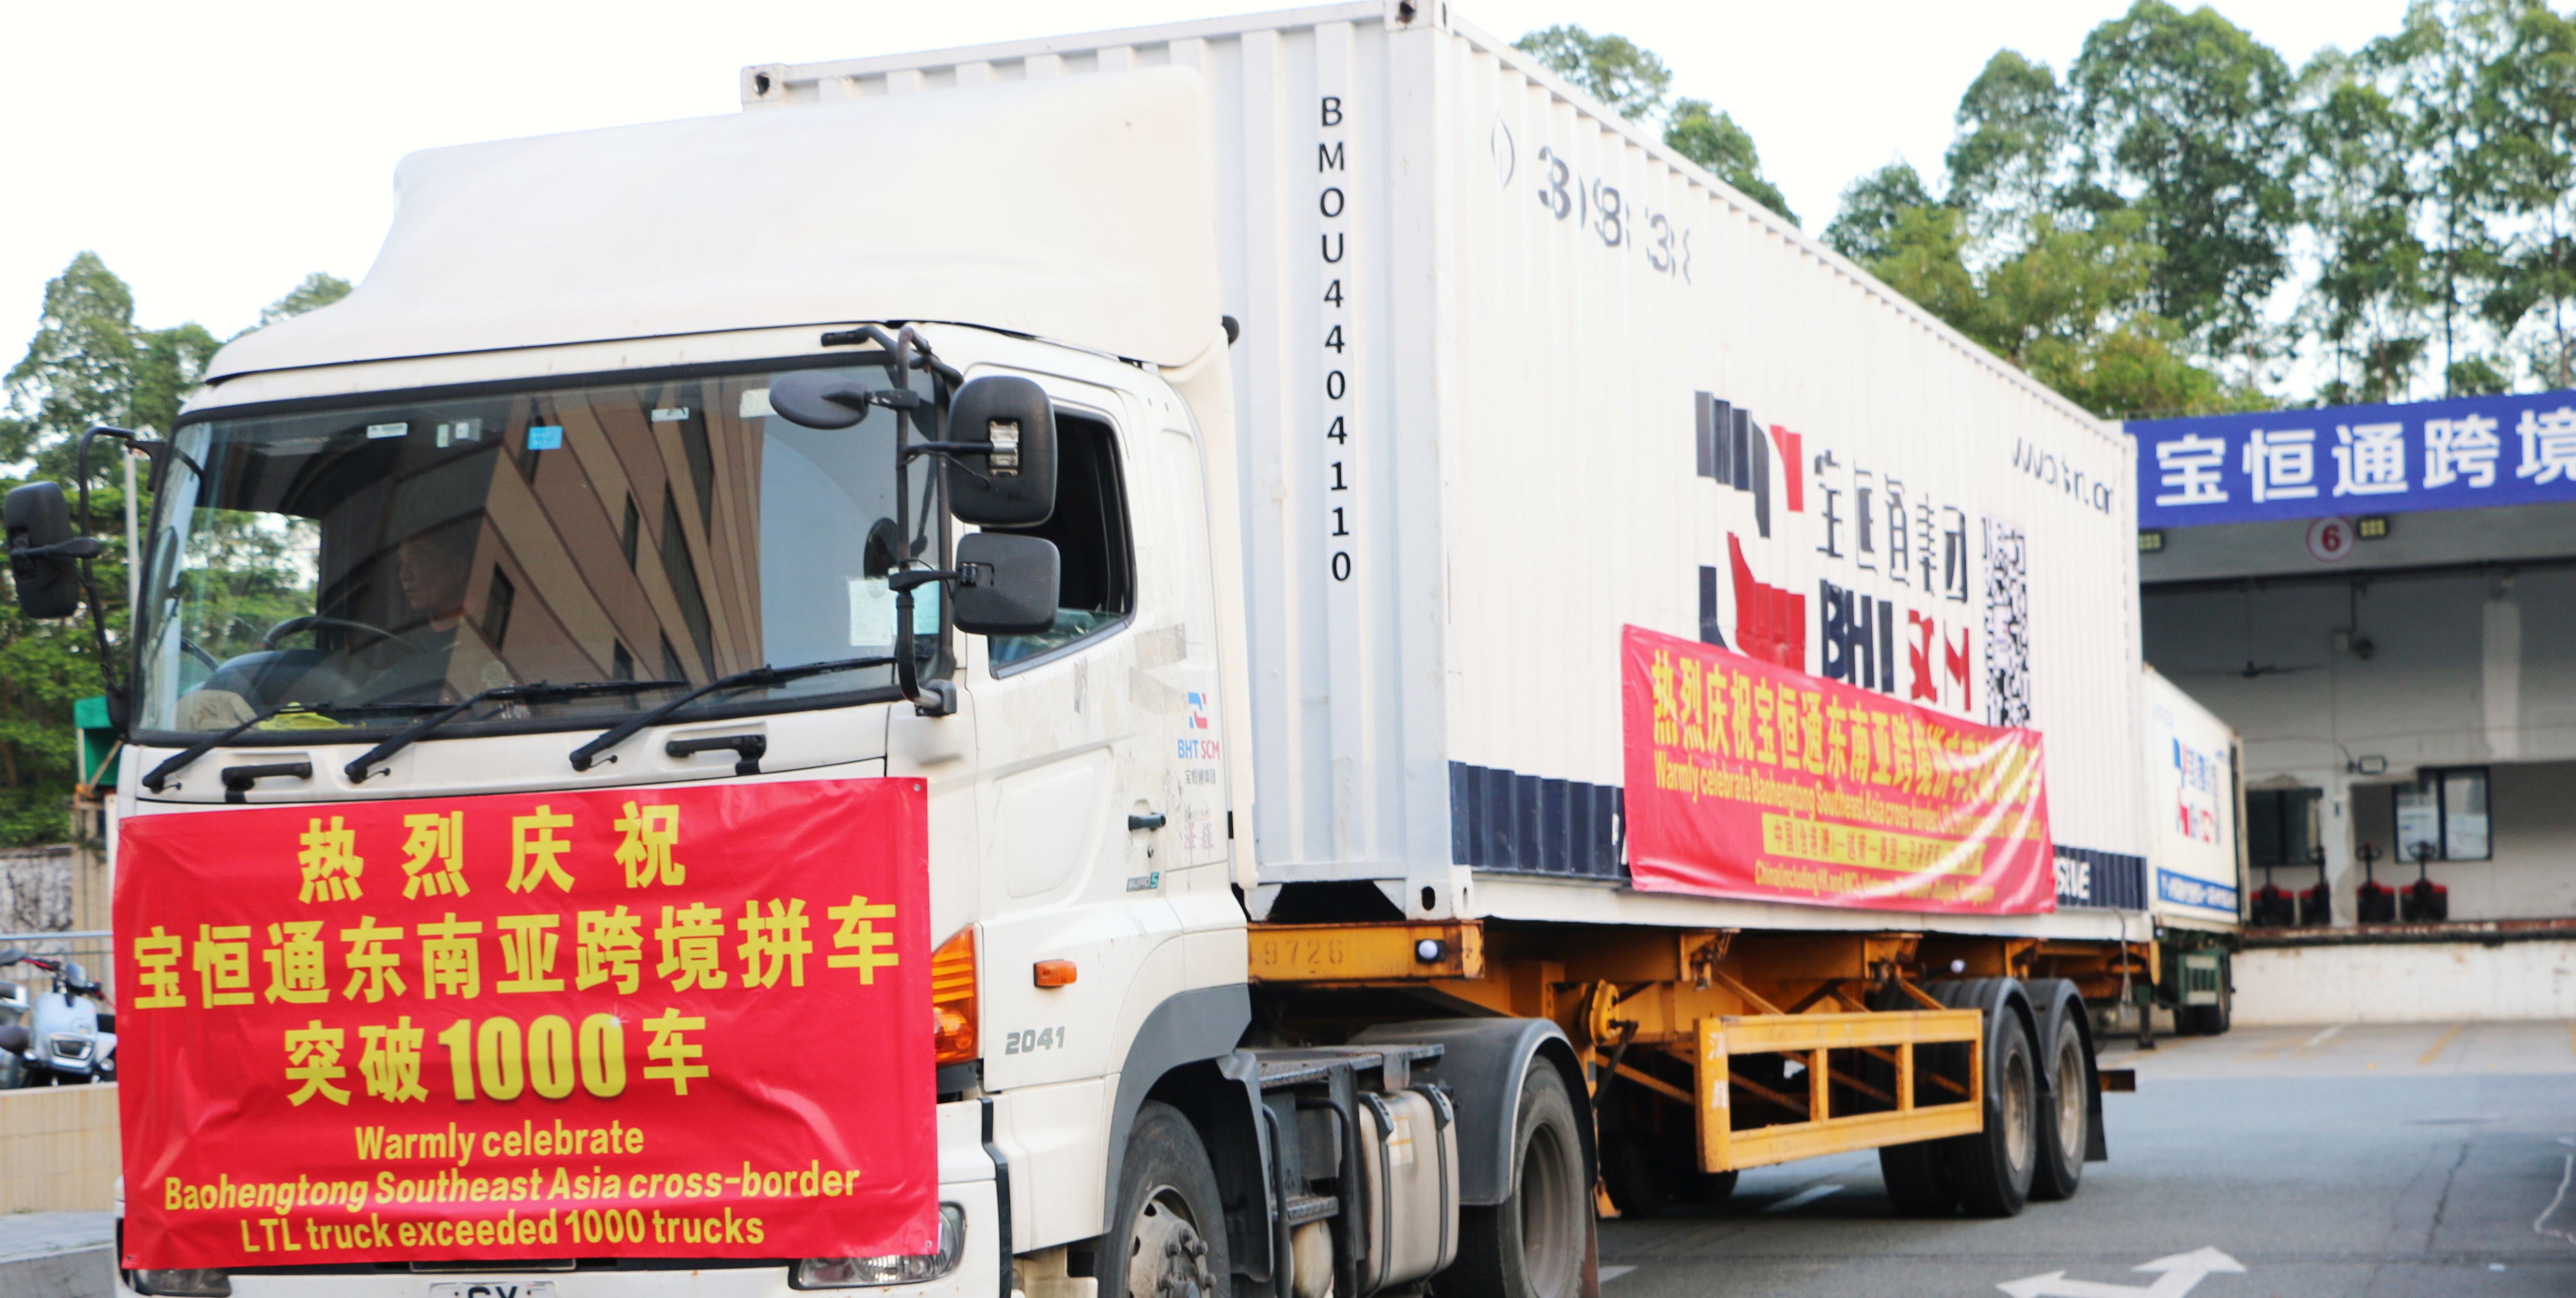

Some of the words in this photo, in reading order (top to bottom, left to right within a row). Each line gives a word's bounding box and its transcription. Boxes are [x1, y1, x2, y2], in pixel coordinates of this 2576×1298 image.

[2155, 407, 2576, 506] 宝恒通跨境
[2321, 525, 2340, 552] 6
[1178, 739, 1199, 759] BHT
[1201, 740, 1220, 759] SCM
[1654, 750, 1698, 803] Warmly
[1700, 758, 1752, 802] celebrate
[298, 801, 685, 903] 热烈庆祝
[134, 895, 899, 1009] 宝恒通东南亚跨境拼车
[285, 1008, 708, 1105] 突破1000车
[1005, 1026, 1064, 1055] 2041
[355, 1123, 475, 1167] Warmly
[483, 1120, 644, 1157] celebrate
[166, 1174, 368, 1215] Baohengtong
[375, 1168, 543, 1202] Southeast
[549, 1166, 621, 1198] Asia
[629, 1160, 859, 1197] cross-border
[241, 1218, 301, 1252] LTL
[306, 1213, 392, 1250] truck
[399, 1210, 558, 1246] exceeded
[565, 1209, 645, 1243] 1000
[652, 1208, 764, 1244] trucks
